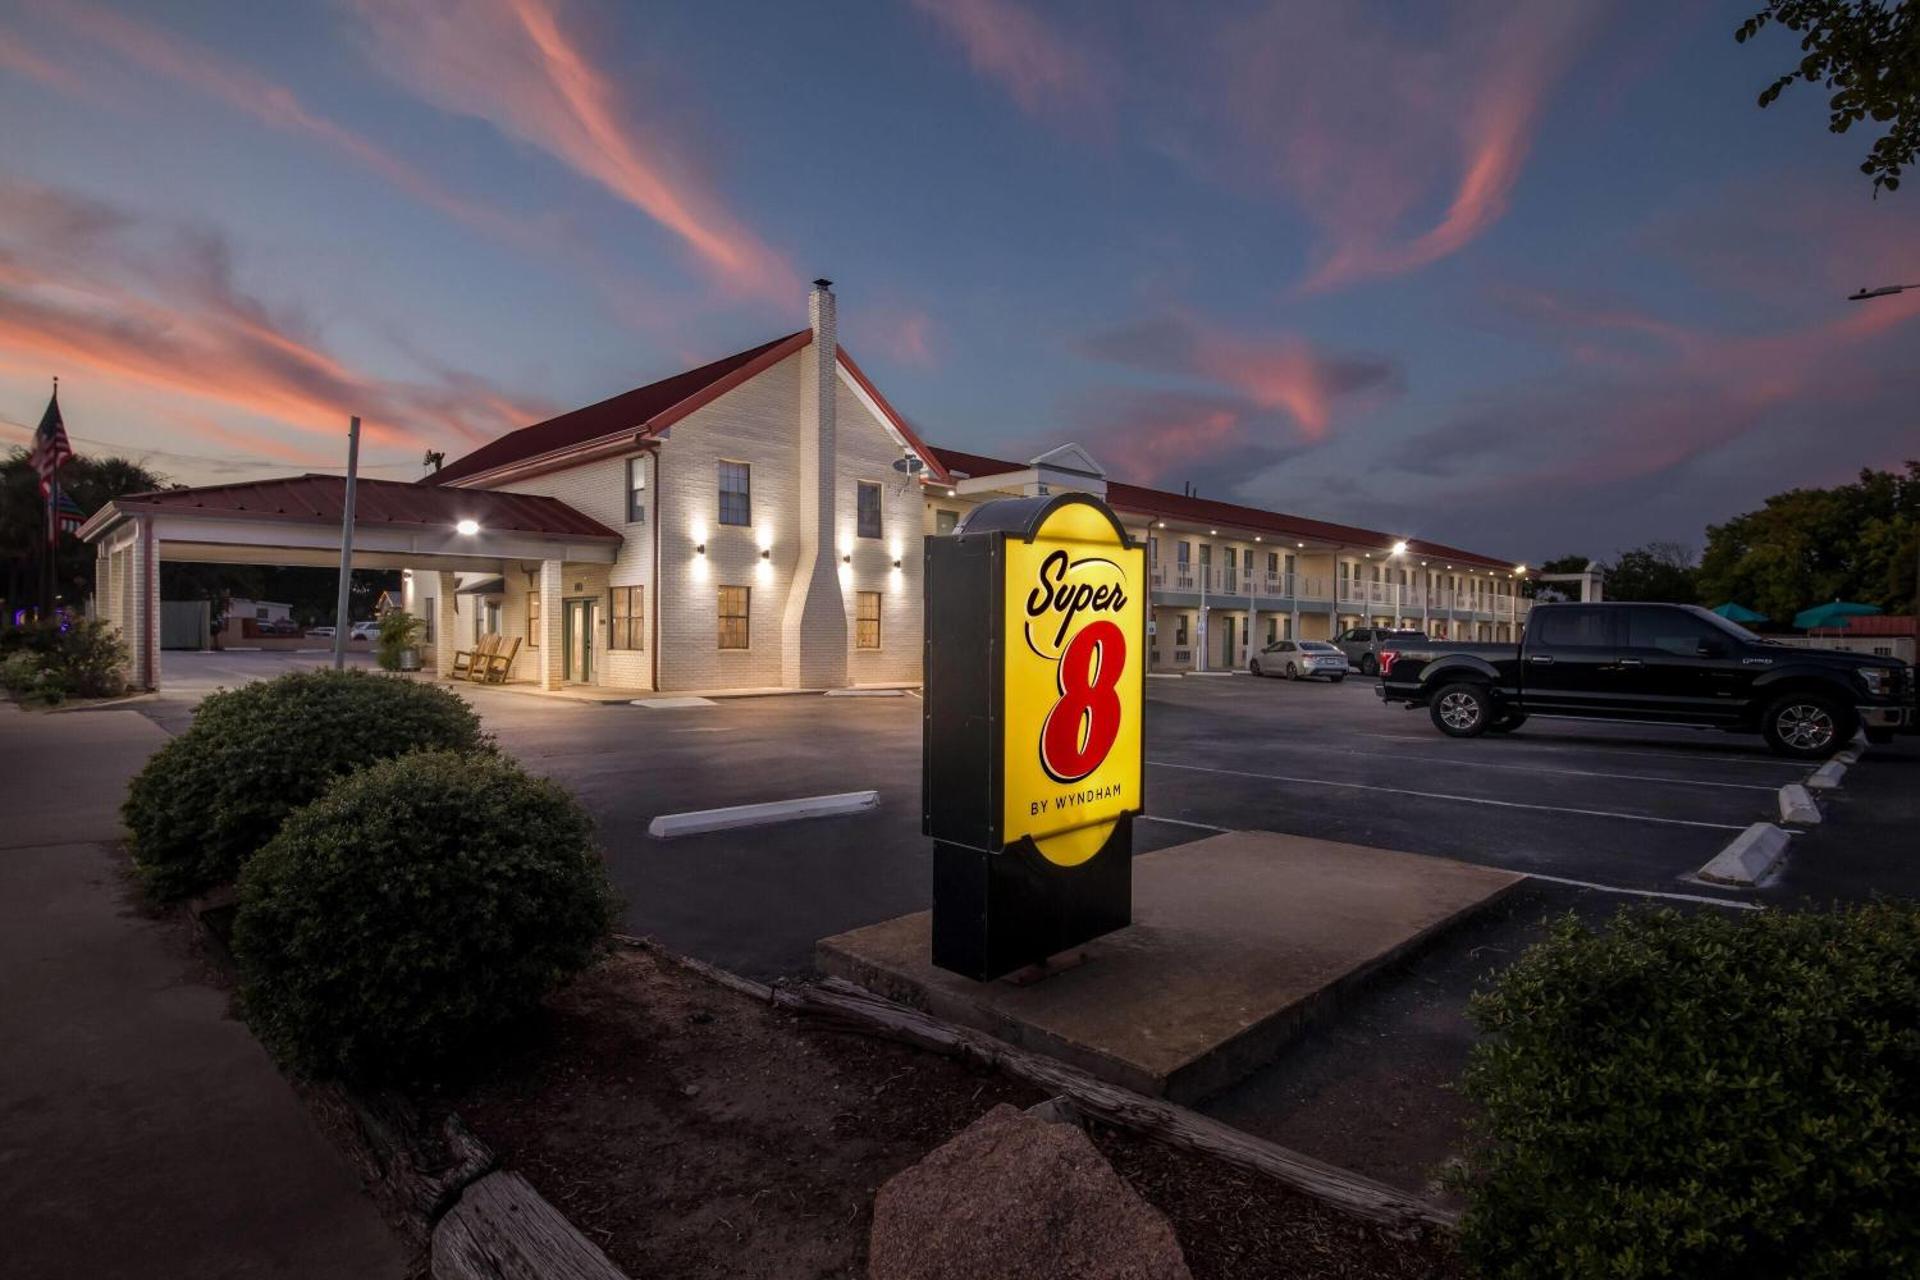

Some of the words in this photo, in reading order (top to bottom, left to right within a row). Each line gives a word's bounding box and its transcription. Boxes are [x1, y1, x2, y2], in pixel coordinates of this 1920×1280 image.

[1027, 550, 1127, 648] Super
[1040, 620, 1127, 784] 8
[1030, 799, 1049, 816] BY
[1056, 784, 1122, 811] WYNDHAM
